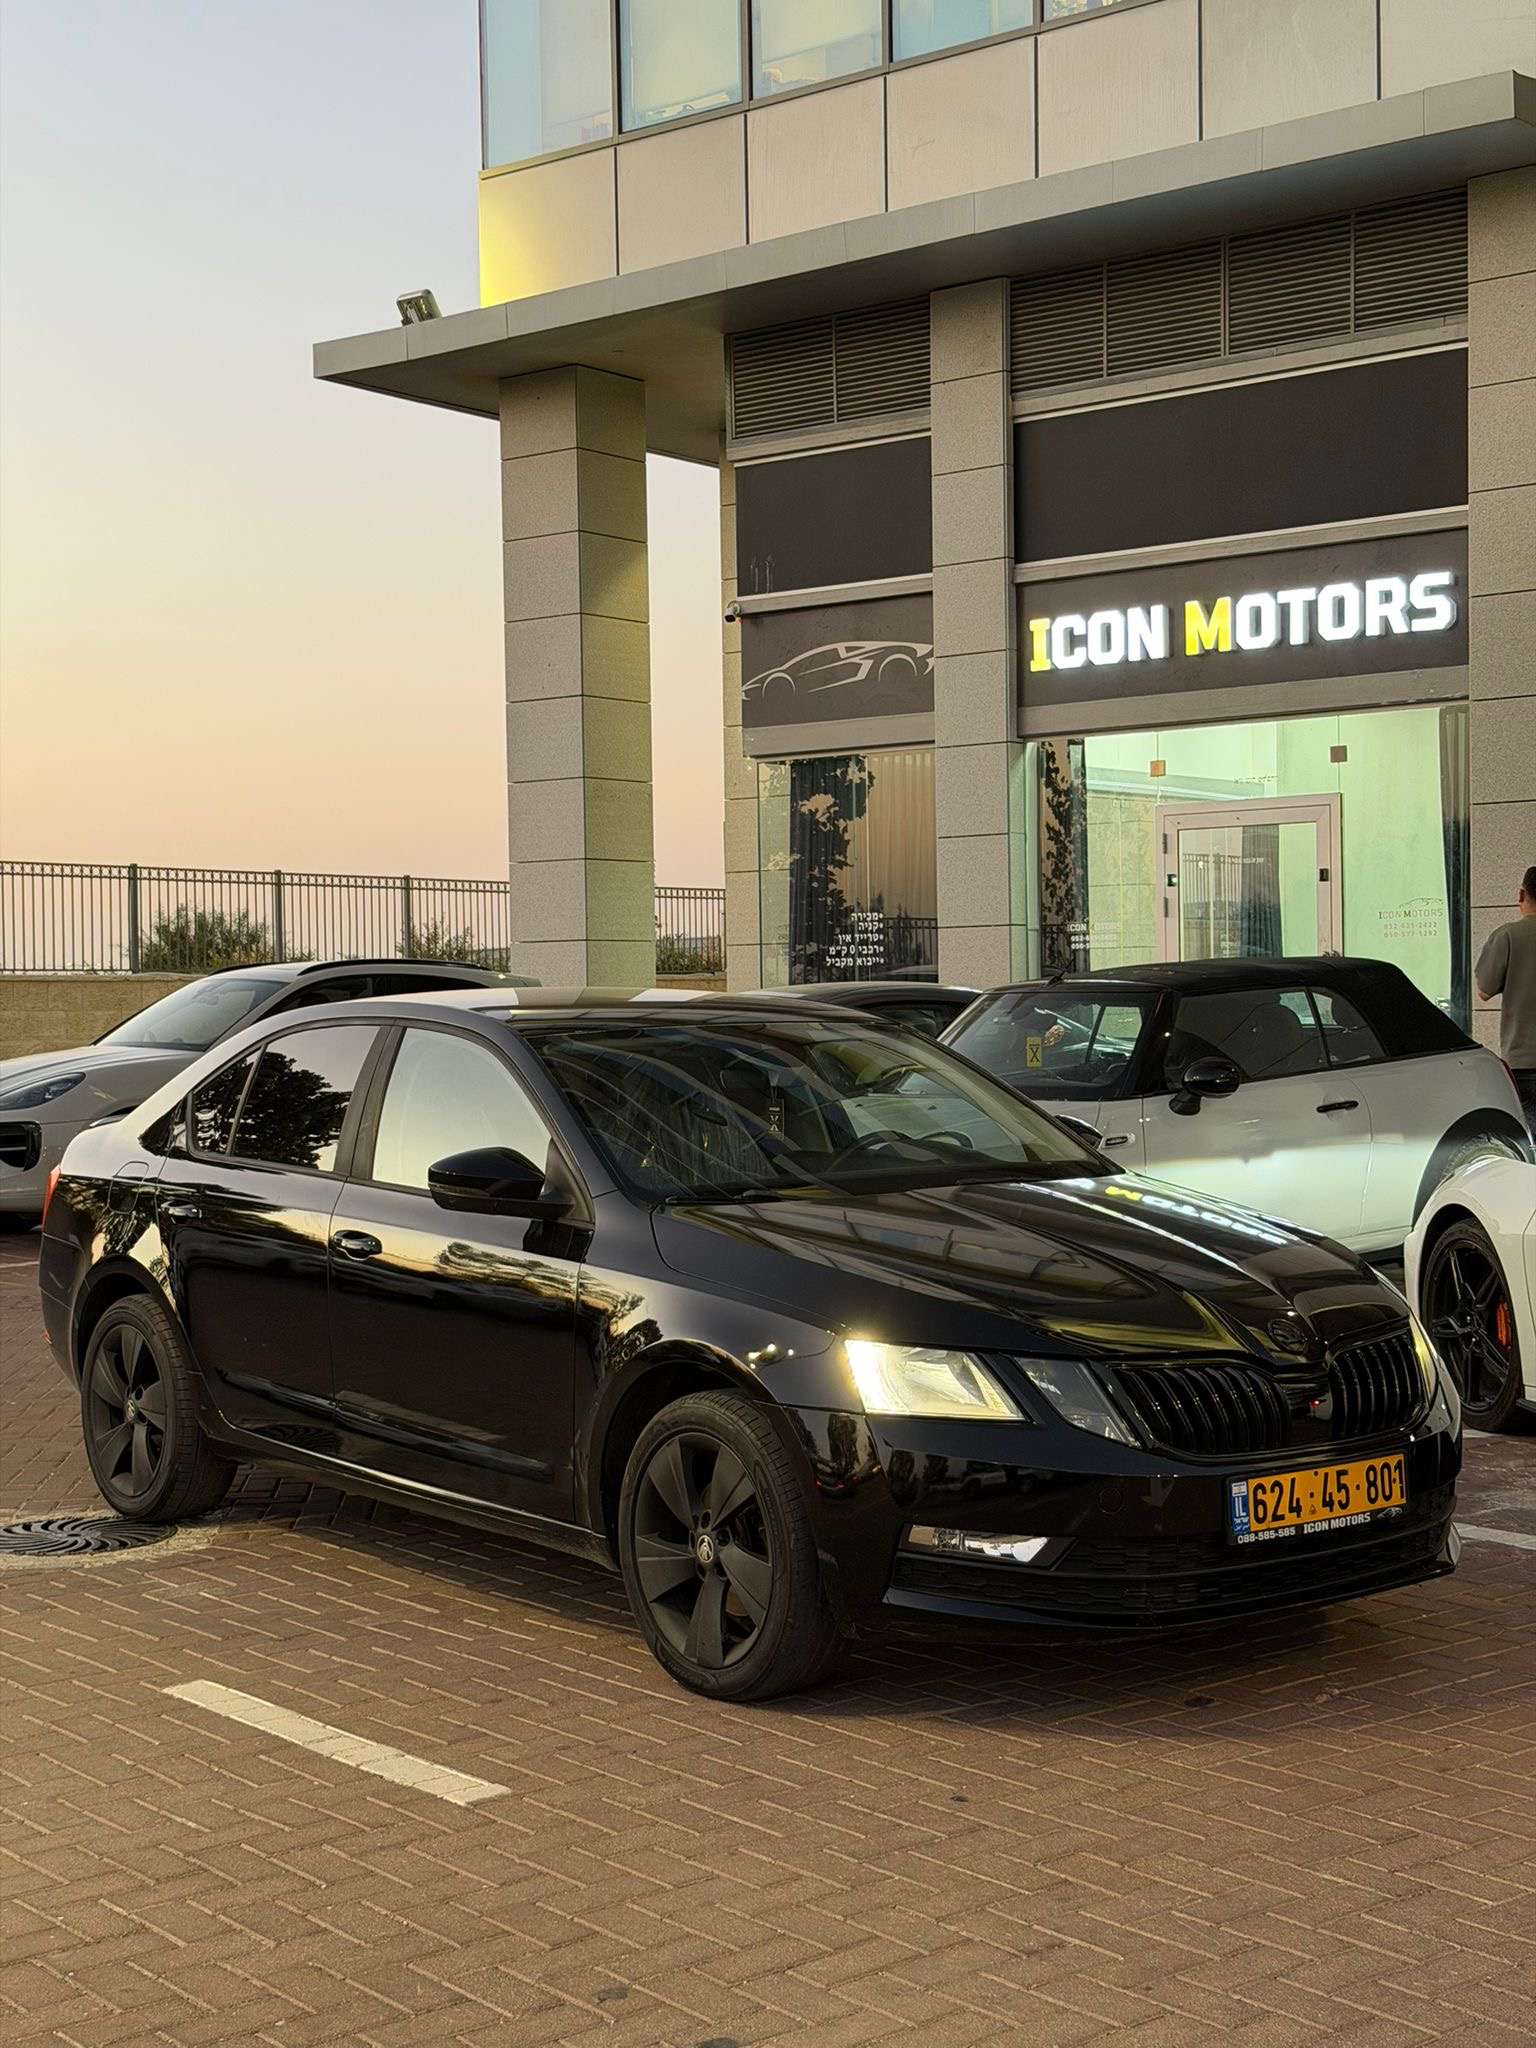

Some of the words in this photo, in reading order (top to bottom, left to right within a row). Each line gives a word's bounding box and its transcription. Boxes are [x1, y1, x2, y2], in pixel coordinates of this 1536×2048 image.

[1029, 604, 1170, 672] ICON
[1184, 571, 1458, 657] MOTORS
[851, 912, 879, 921] מכירה
[1379, 911, 1401, 919] ICON
[1403, 909, 1443, 918] MOTORS
[858, 921, 879, 932] קניה
[838, 933, 852, 945] אין
[854, 933, 879, 942] טרייד
[859, 945, 879, 954] רכבי
[825, 956, 854, 968] מקביל
[856, 957, 880, 966] ייבוא
[1235, 1496, 1247, 1517] IL
[1237, 1526, 1296, 1544] 088-585-585
[1303, 1521, 1329, 1534] ICON
[1331, 1512, 1371, 1529] MOTORS
